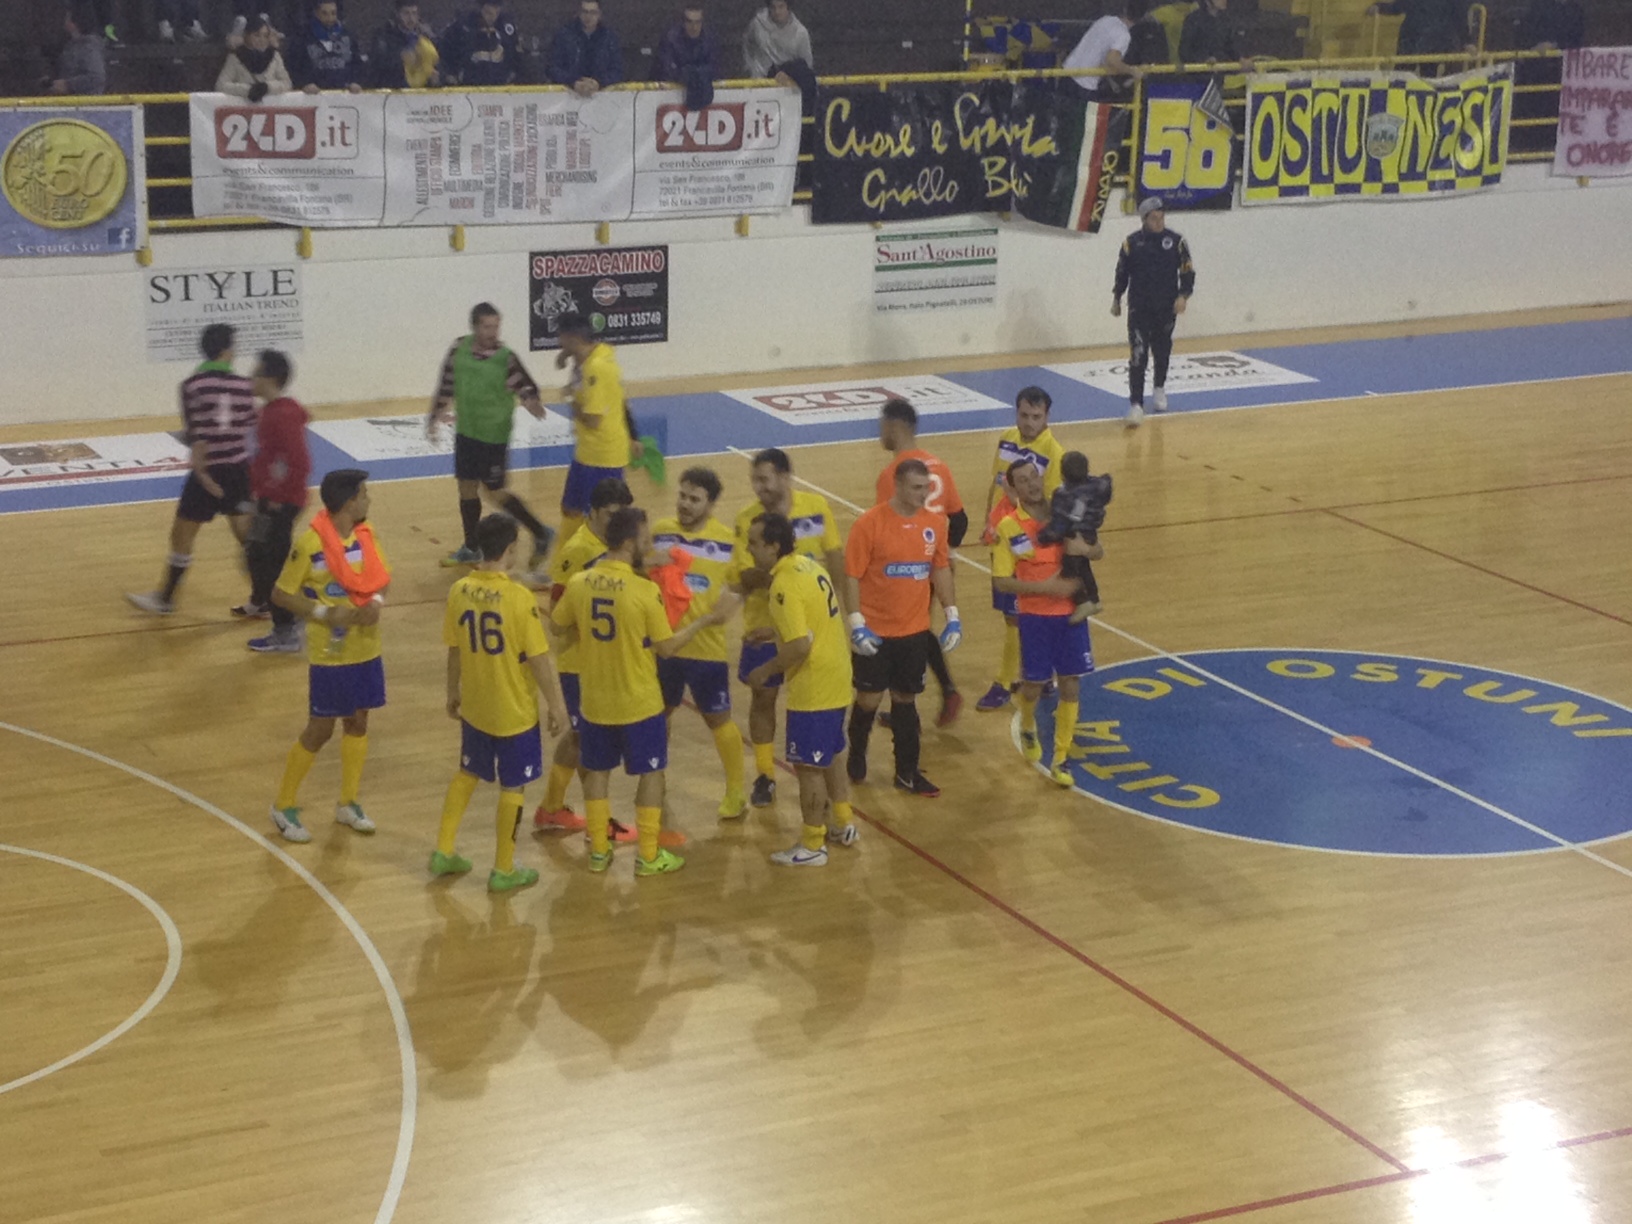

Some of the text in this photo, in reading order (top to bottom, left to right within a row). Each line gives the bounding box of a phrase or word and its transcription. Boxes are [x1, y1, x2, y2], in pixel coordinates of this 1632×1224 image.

[150, 268, 298, 304] STYLE
[532, 249, 665, 280] SPAZZACAMINO
[203, 300, 253, 313] ITALIAN
[816, 574, 839, 618] 2
[458, 609, 505, 656] 16
[591, 597, 616, 642] 5
[1102, 667, 1208, 701] DI
[1265, 658, 1632, 738] OSTUNI
